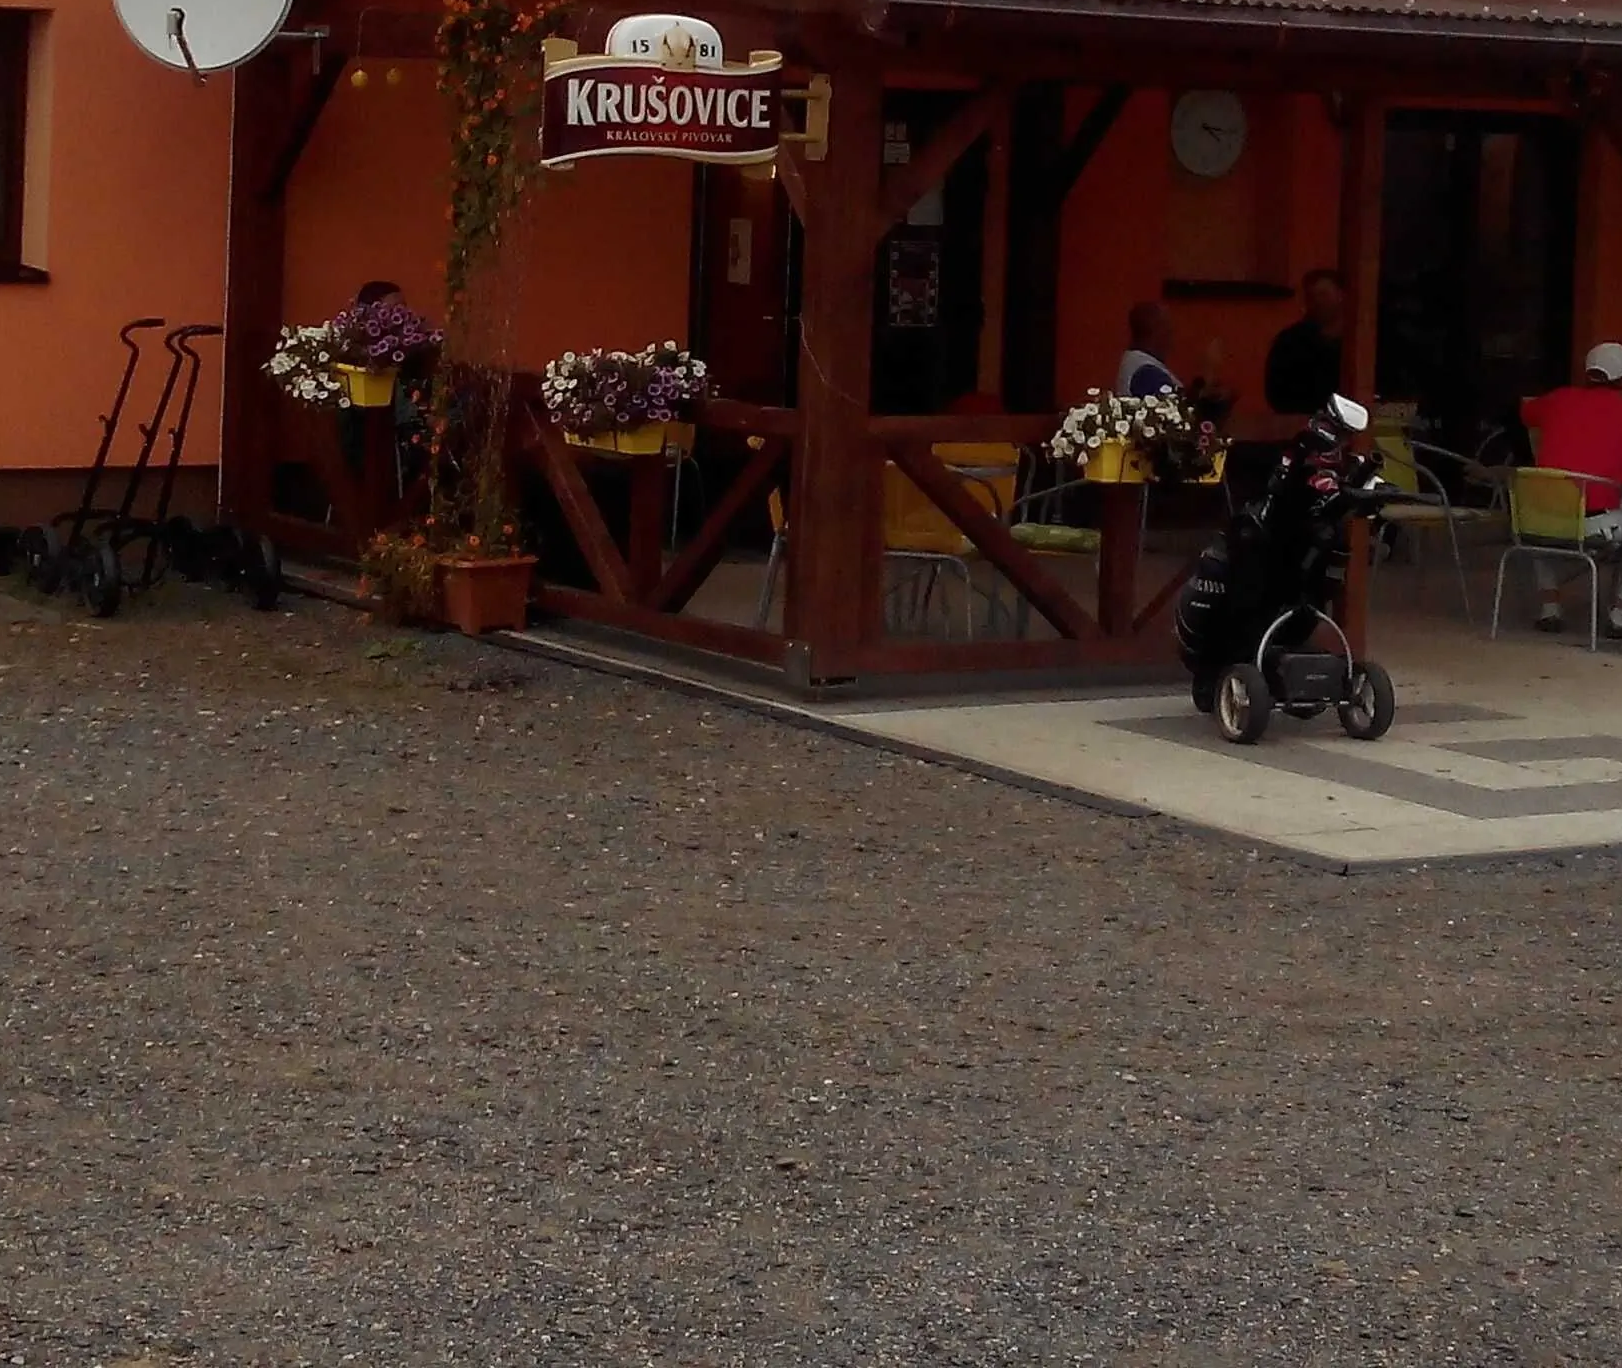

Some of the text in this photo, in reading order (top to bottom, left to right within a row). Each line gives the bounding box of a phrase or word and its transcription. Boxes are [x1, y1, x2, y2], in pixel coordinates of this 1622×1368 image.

[631, 39, 717, 59] 15 81
[566, 75, 771, 129] KRUŠOVICE
[681, 131, 733, 144] PIVOVAR
